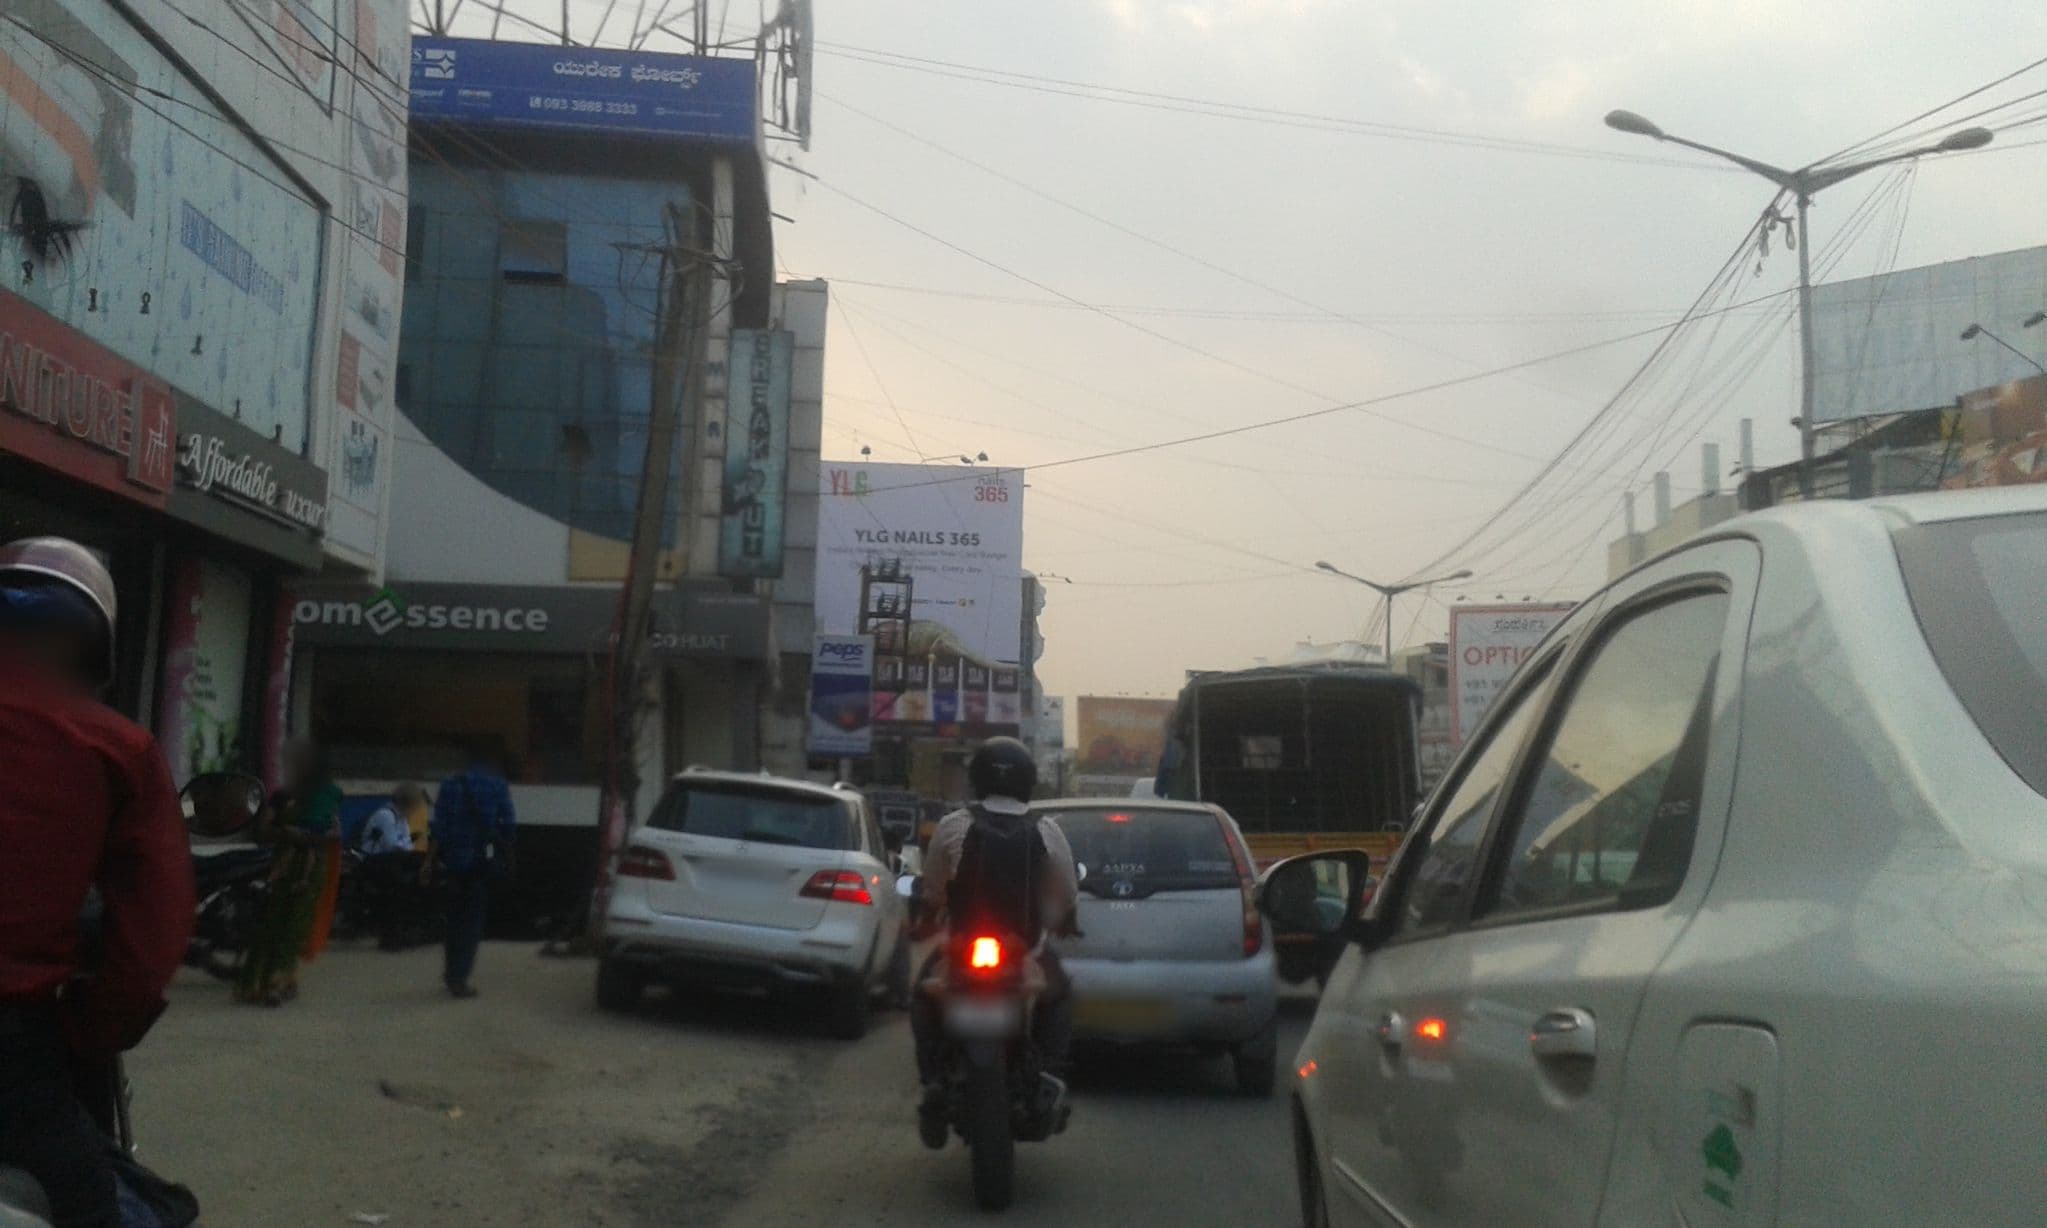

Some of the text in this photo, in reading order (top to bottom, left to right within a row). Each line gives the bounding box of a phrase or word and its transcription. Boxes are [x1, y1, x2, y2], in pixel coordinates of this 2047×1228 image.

[181, 433, 278, 506] Affordable
[830, 470, 868, 497] YLG
[974, 486, 1009, 502] 365
[854, 530, 980, 547] YLG NAILS 365
[294, 599, 548, 635] omessence
[819, 642, 865, 659] peps
